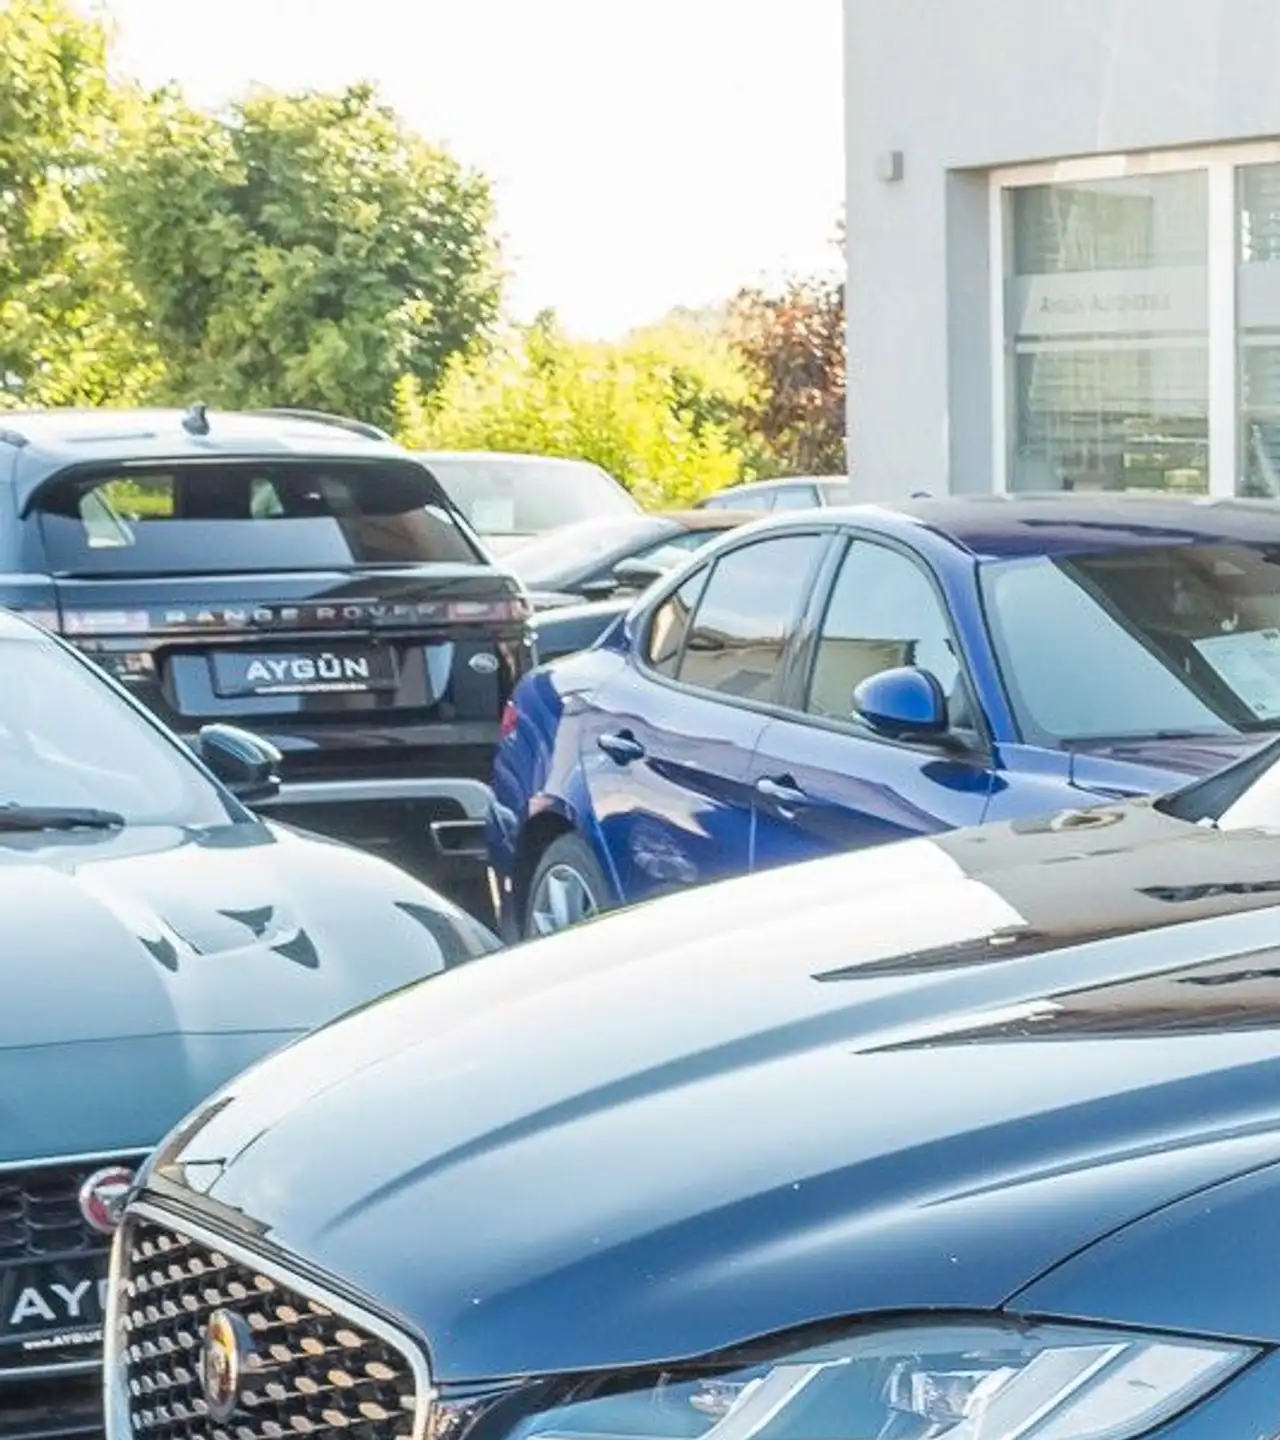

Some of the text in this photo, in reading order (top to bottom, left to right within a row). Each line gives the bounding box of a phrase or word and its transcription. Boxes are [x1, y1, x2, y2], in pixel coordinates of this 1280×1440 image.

[164, 604, 437, 623] RANGE ROVER
[247, 653, 369, 681] AYGÜN
[9, 1279, 108, 1325] AY
